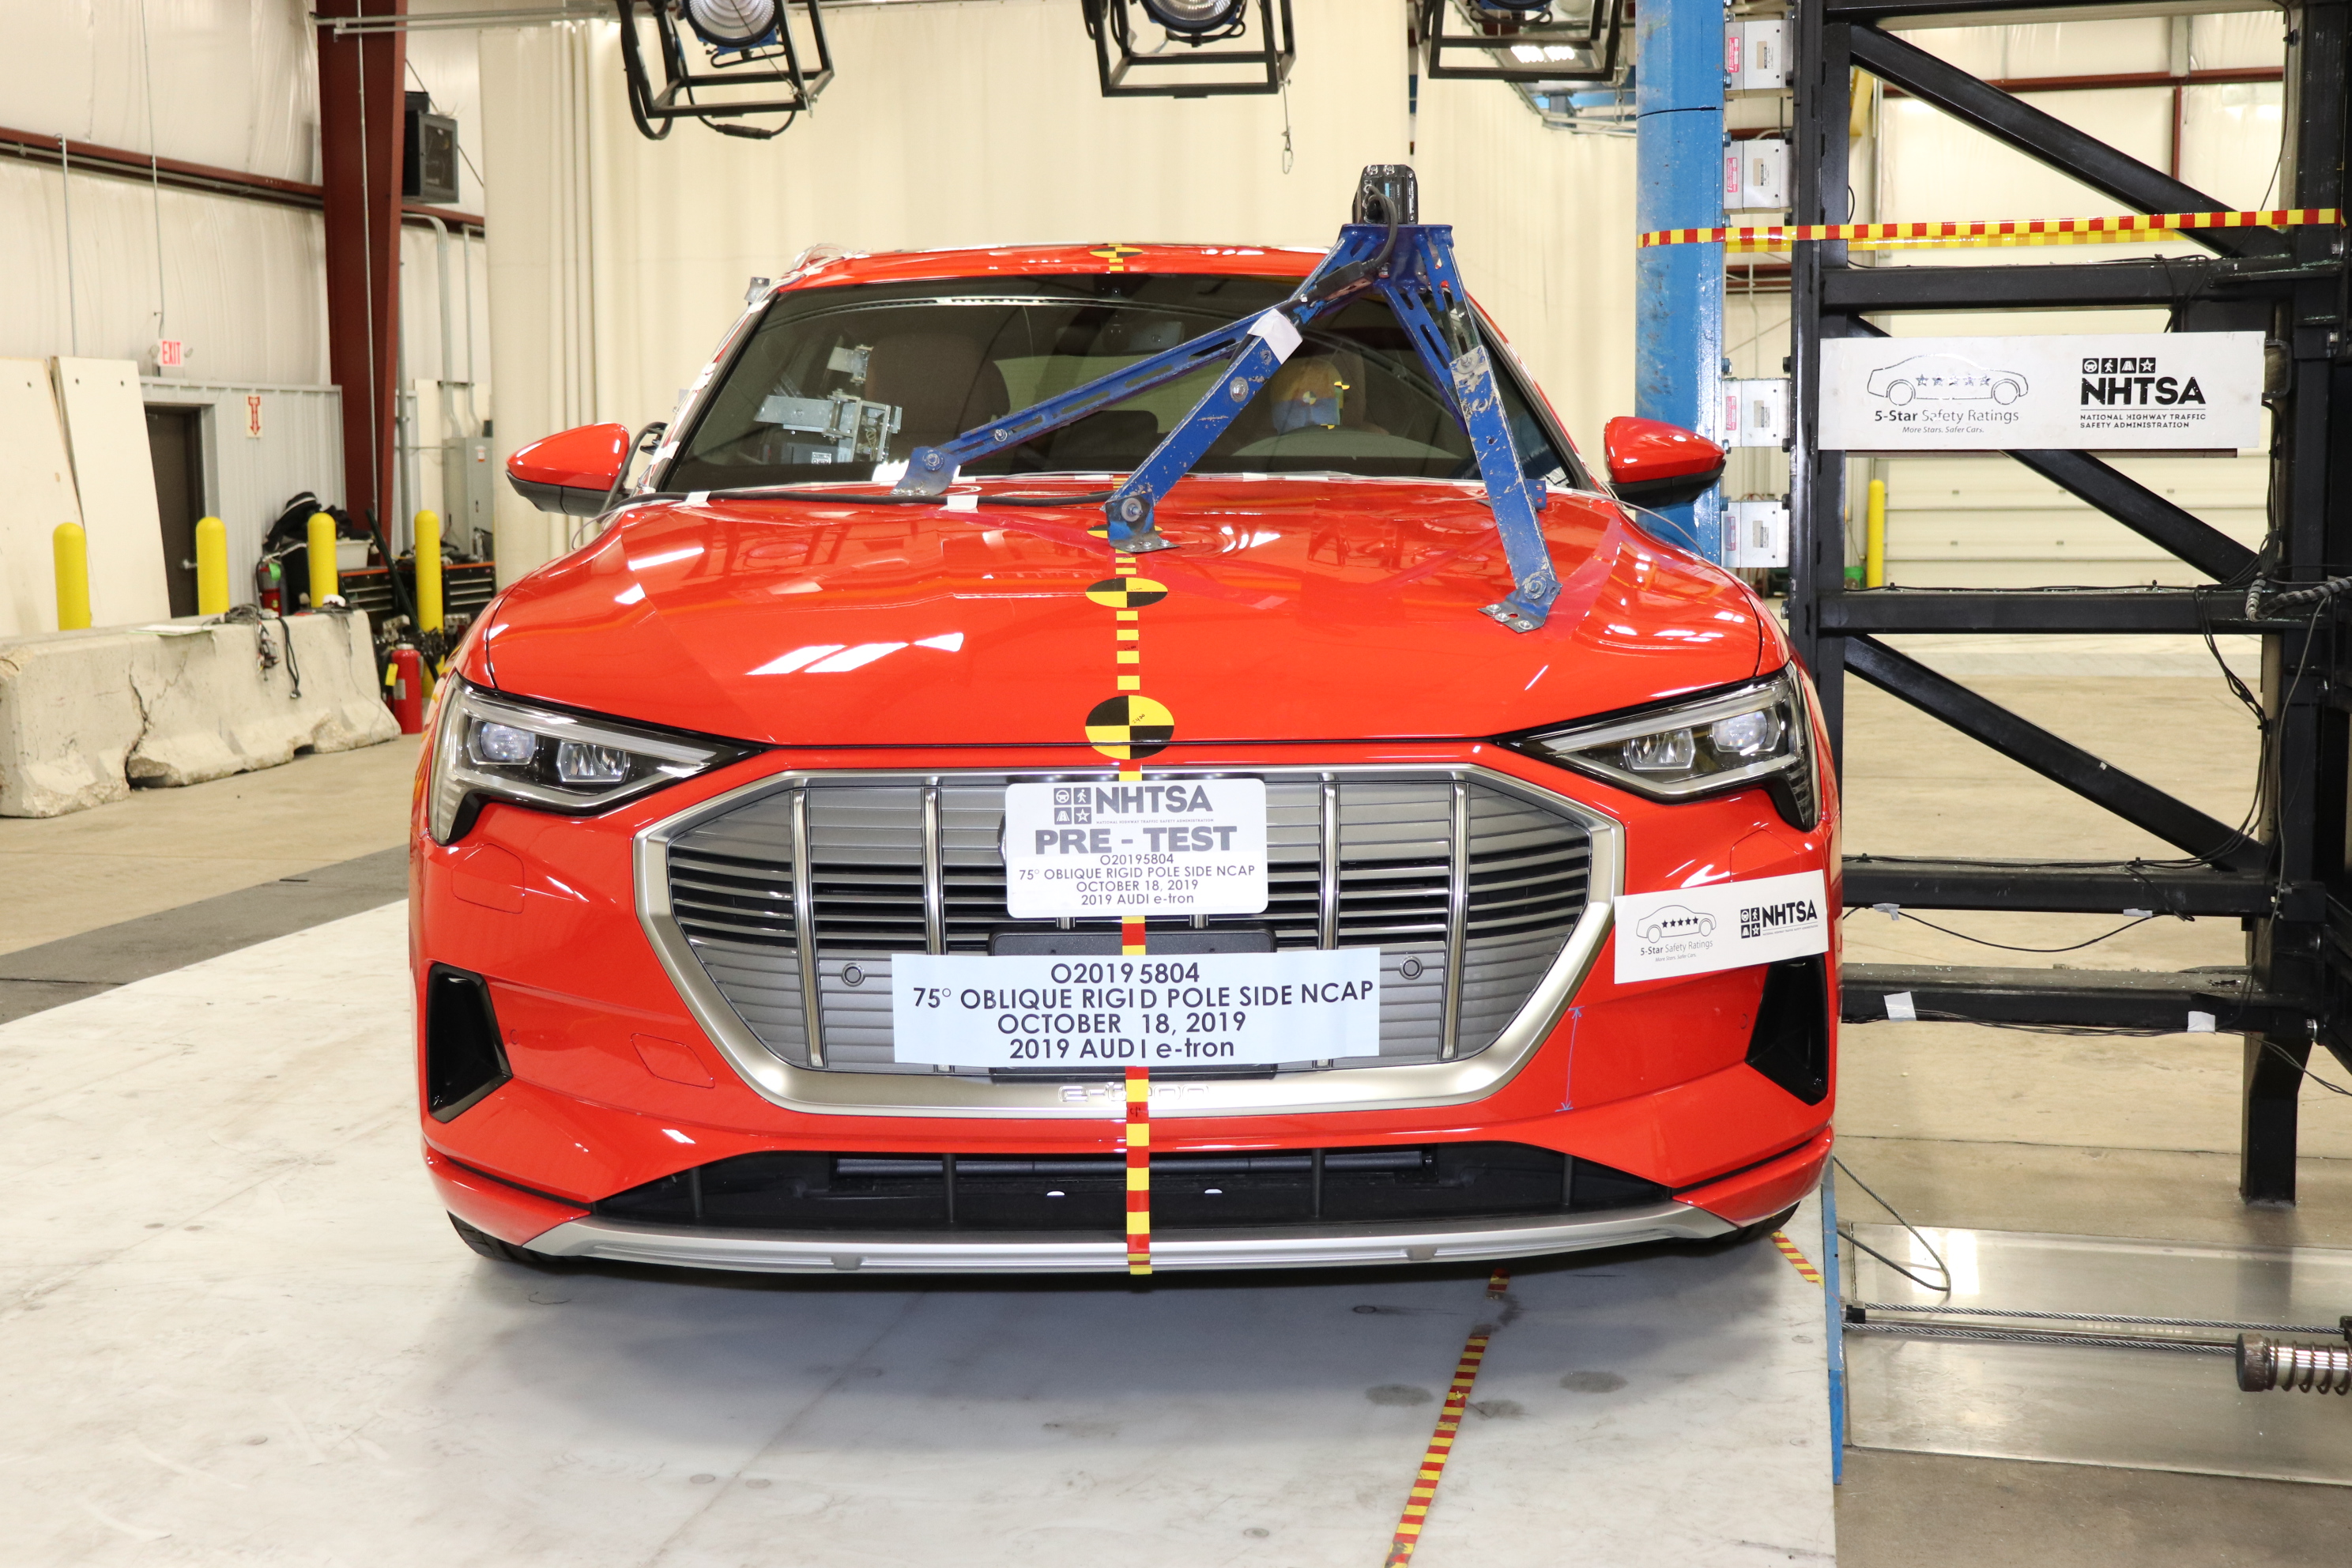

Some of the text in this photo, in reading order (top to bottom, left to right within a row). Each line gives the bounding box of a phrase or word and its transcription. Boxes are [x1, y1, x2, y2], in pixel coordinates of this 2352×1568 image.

[162, 341, 181, 365] EXIT
[2080, 376, 2206, 405] NHTSA
[1875, 409, 2019, 424] 5-Star Safety Ratings
[1095, 785, 1213, 814] NHTSA
[1035, 828, 1112, 854] PRE
[1143, 826, 1237, 852] TEST
[1020, 865, 1255, 880] 75° OBLIQUE RIGID POLE SIDE NCAP
[1076, 880, 1198, 892] OCTOBER 18, 2019
[1081, 893, 1194, 905] 2019 AUDI e-tron
[1762, 899, 1818, 928] NHTSA
[1640, 940, 1713, 956] 5-Star Safety Ratings
[913, 980, 1374, 1010] 75° OBLIQUE RIGID POLE SIDE NCAP
[997, 1011, 1246, 1035] OCTOBER 18, 2019
[1009, 1038, 1234, 1059] 2019 AUDI e-tron
[1058, 1082, 1209, 1102] e-ton
